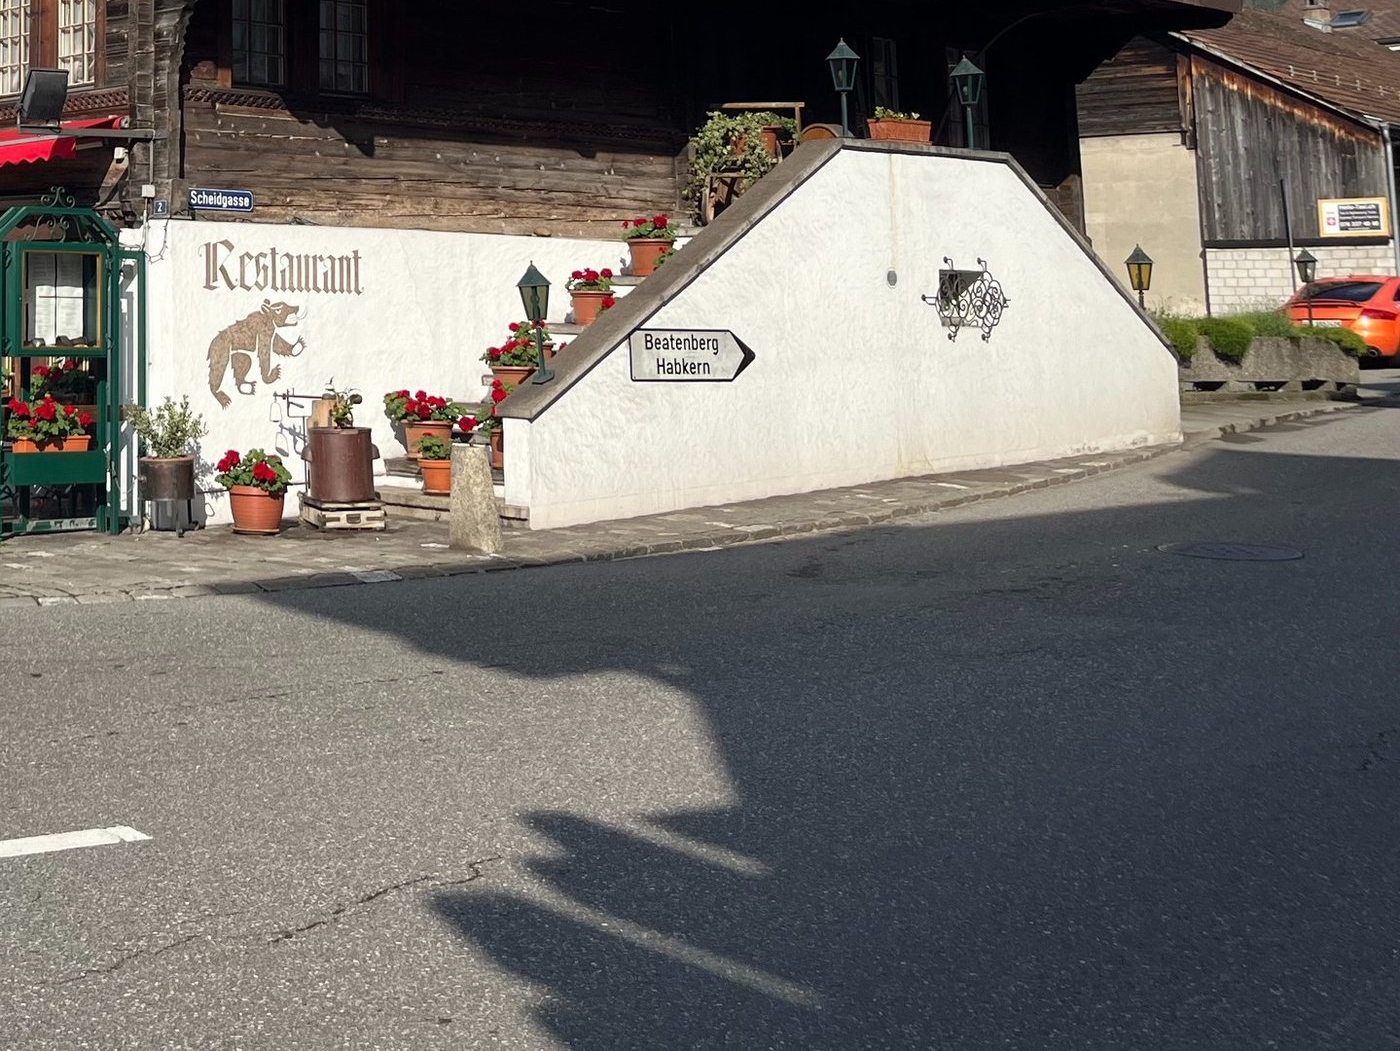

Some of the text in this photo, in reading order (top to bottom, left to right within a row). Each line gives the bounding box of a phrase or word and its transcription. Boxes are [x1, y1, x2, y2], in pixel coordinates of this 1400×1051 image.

[157, 202, 162, 212] 2
[190, 190, 250, 208] Scheidgasse
[198, 239, 365, 296] Restaurant
[644, 333, 719, 355] Beatenberg
[656, 358, 711, 375] Habkern
